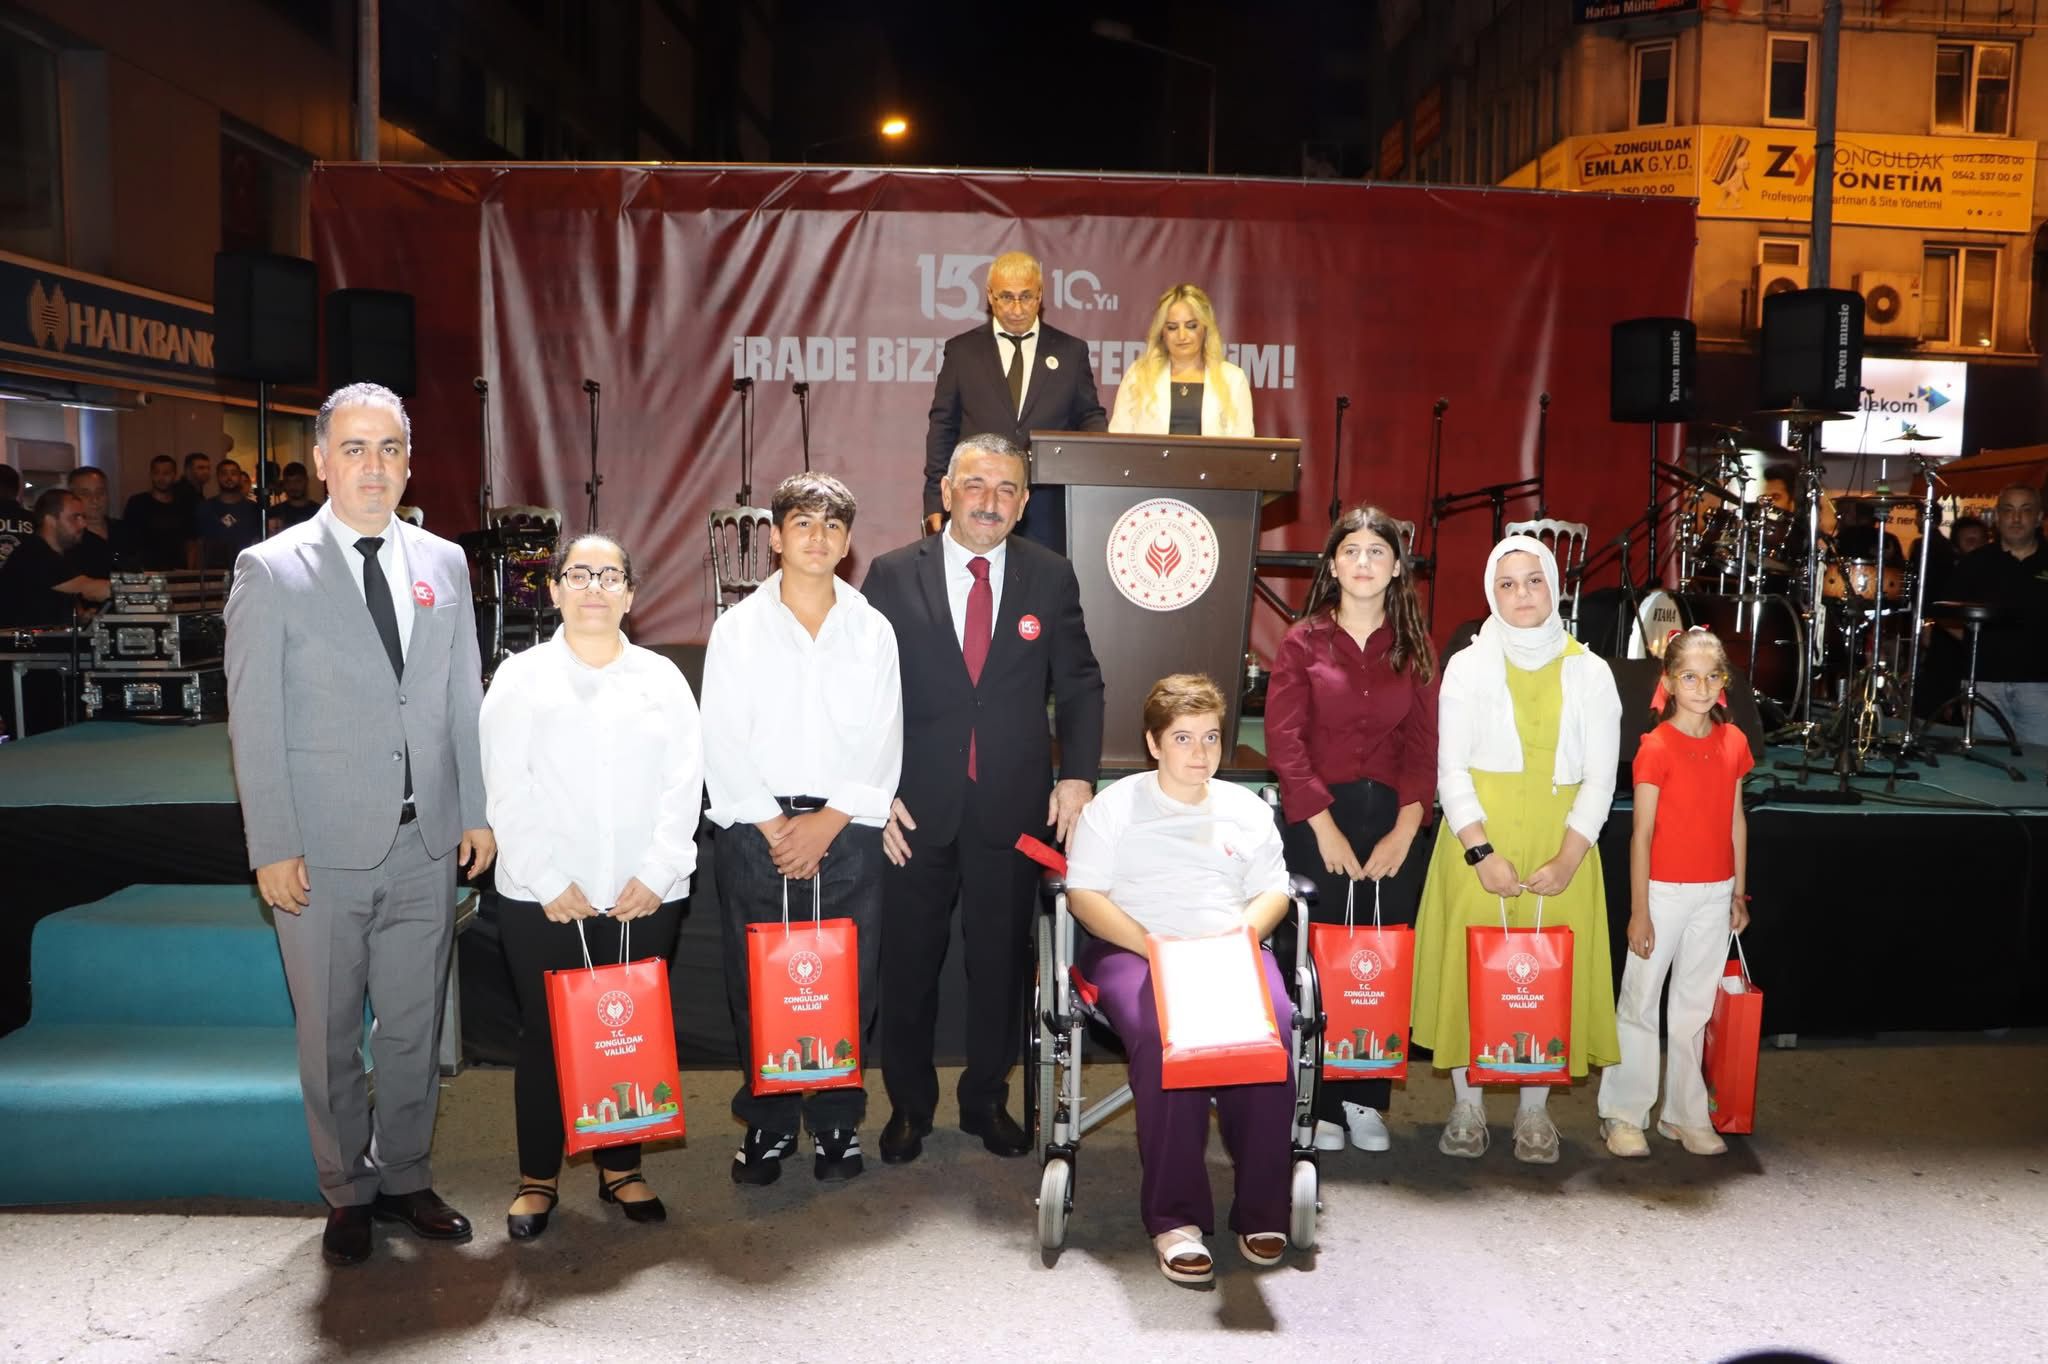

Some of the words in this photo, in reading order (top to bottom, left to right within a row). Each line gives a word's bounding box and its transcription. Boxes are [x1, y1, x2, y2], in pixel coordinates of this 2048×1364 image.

[1614, 137, 1692, 156] ZONGULDAK
[1584, 158, 1644, 177] EMLAK
[1648, 154, 1692, 172] G.Y.D.
[1834, 148, 1944, 170] ONGULDAK
[1660, 184, 1675, 194] 00
[1761, 190, 1814, 203] Profesyone
[1879, 197, 1898, 207] Site
[1901, 198, 1942, 209] Yönetimi
[1836, 304, 1850, 346] music
[69, 302, 214, 369] HALKBANK
[1671, 330, 1681, 366] music
[1835, 350, 1848, 389] Yaren
[1669, 369, 1681, 402] Yaren
[800, 987, 813, 995] T.C.
[1343, 990, 1386, 998] ZONGULDAK
[1501, 993, 1545, 1001] ZONGULDAK
[1516, 986, 1529, 994] T.C.
[783, 994, 830, 1005] ZONGULDAK
[1350, 997, 1378, 1005] VALİLİĞİ
[1508, 1000, 1537, 1009] VALİLİĞİ
[792, 1003, 822, 1012] VALİLİĞİ
[610, 1029, 625, 1038] T.C.
[594, 1034, 644, 1049] ZONGULDAK
[604, 1043, 636, 1057] VALİLİĞİ
